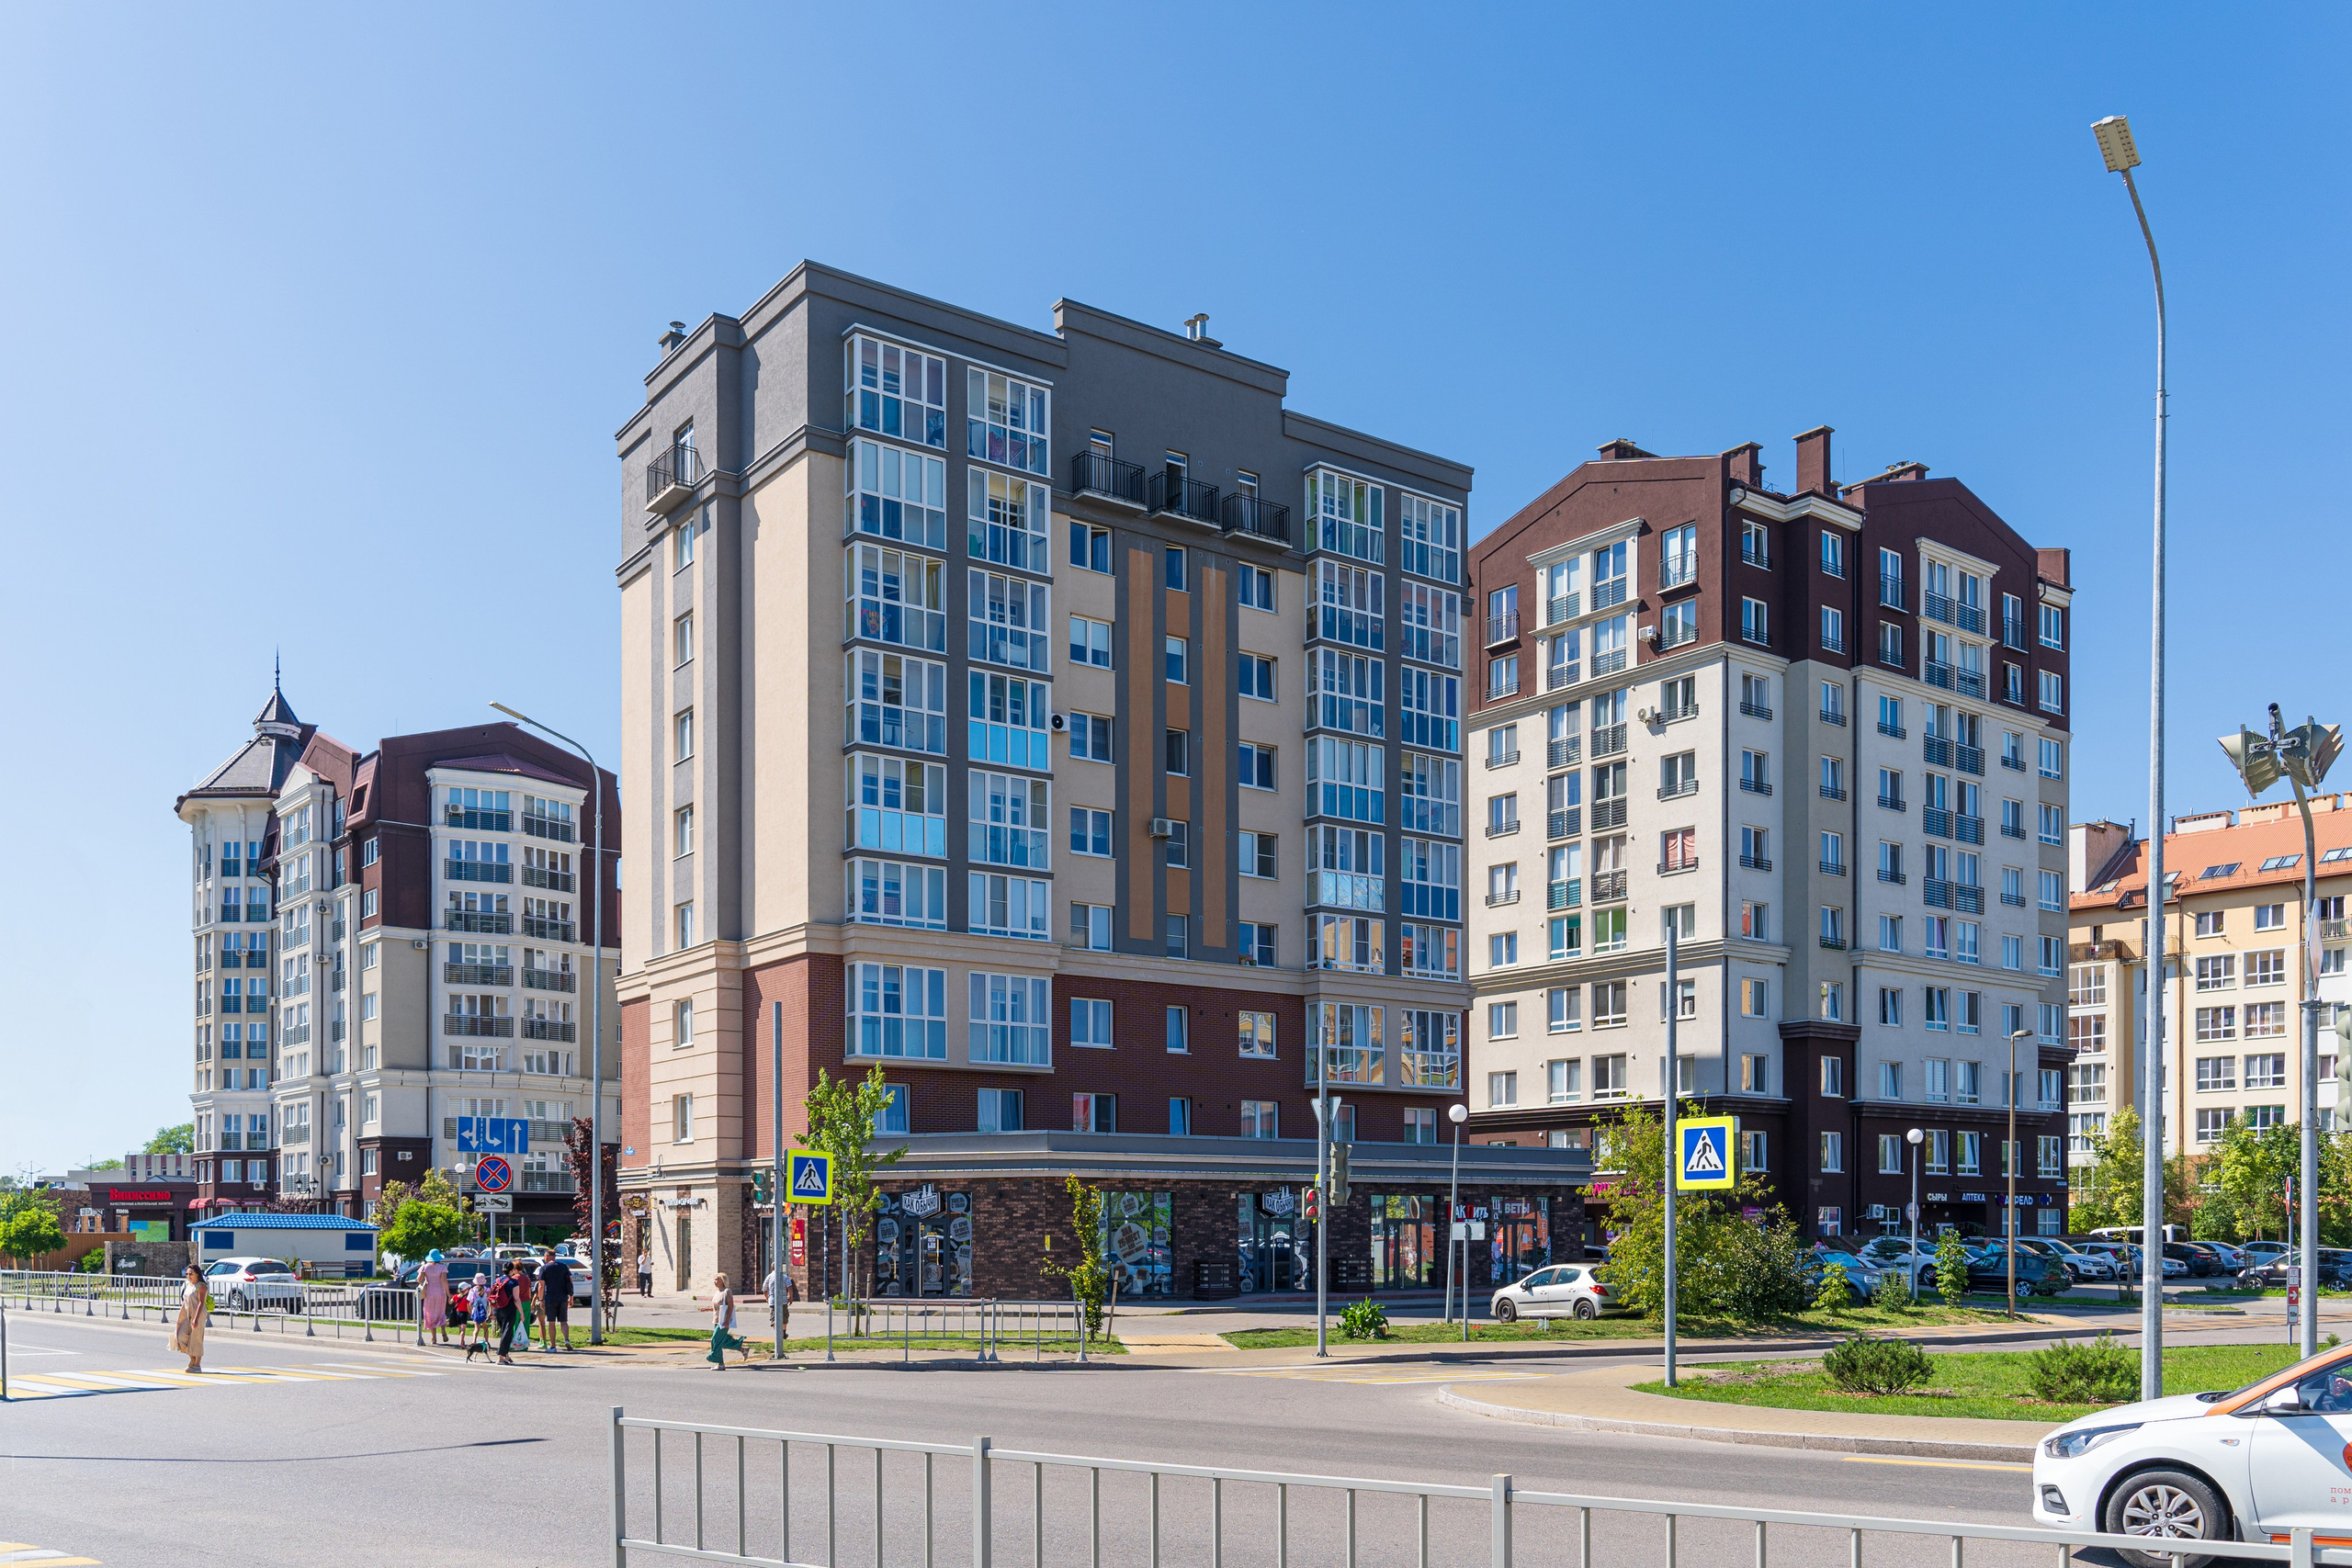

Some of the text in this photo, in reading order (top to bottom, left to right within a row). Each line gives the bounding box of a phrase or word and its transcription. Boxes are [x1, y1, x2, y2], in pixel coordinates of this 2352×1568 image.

[1927, 1193, 1947, 1201] СЫРЫ
[1962, 1193, 1986, 1201] АПТЕКА
[2004, 1196, 2033, 1205] АРЕЛЬ
[904, 1196, 936, 1212] КАК ОБЫЧНО
[1125, 1231, 1140, 1245] МЕСТ
